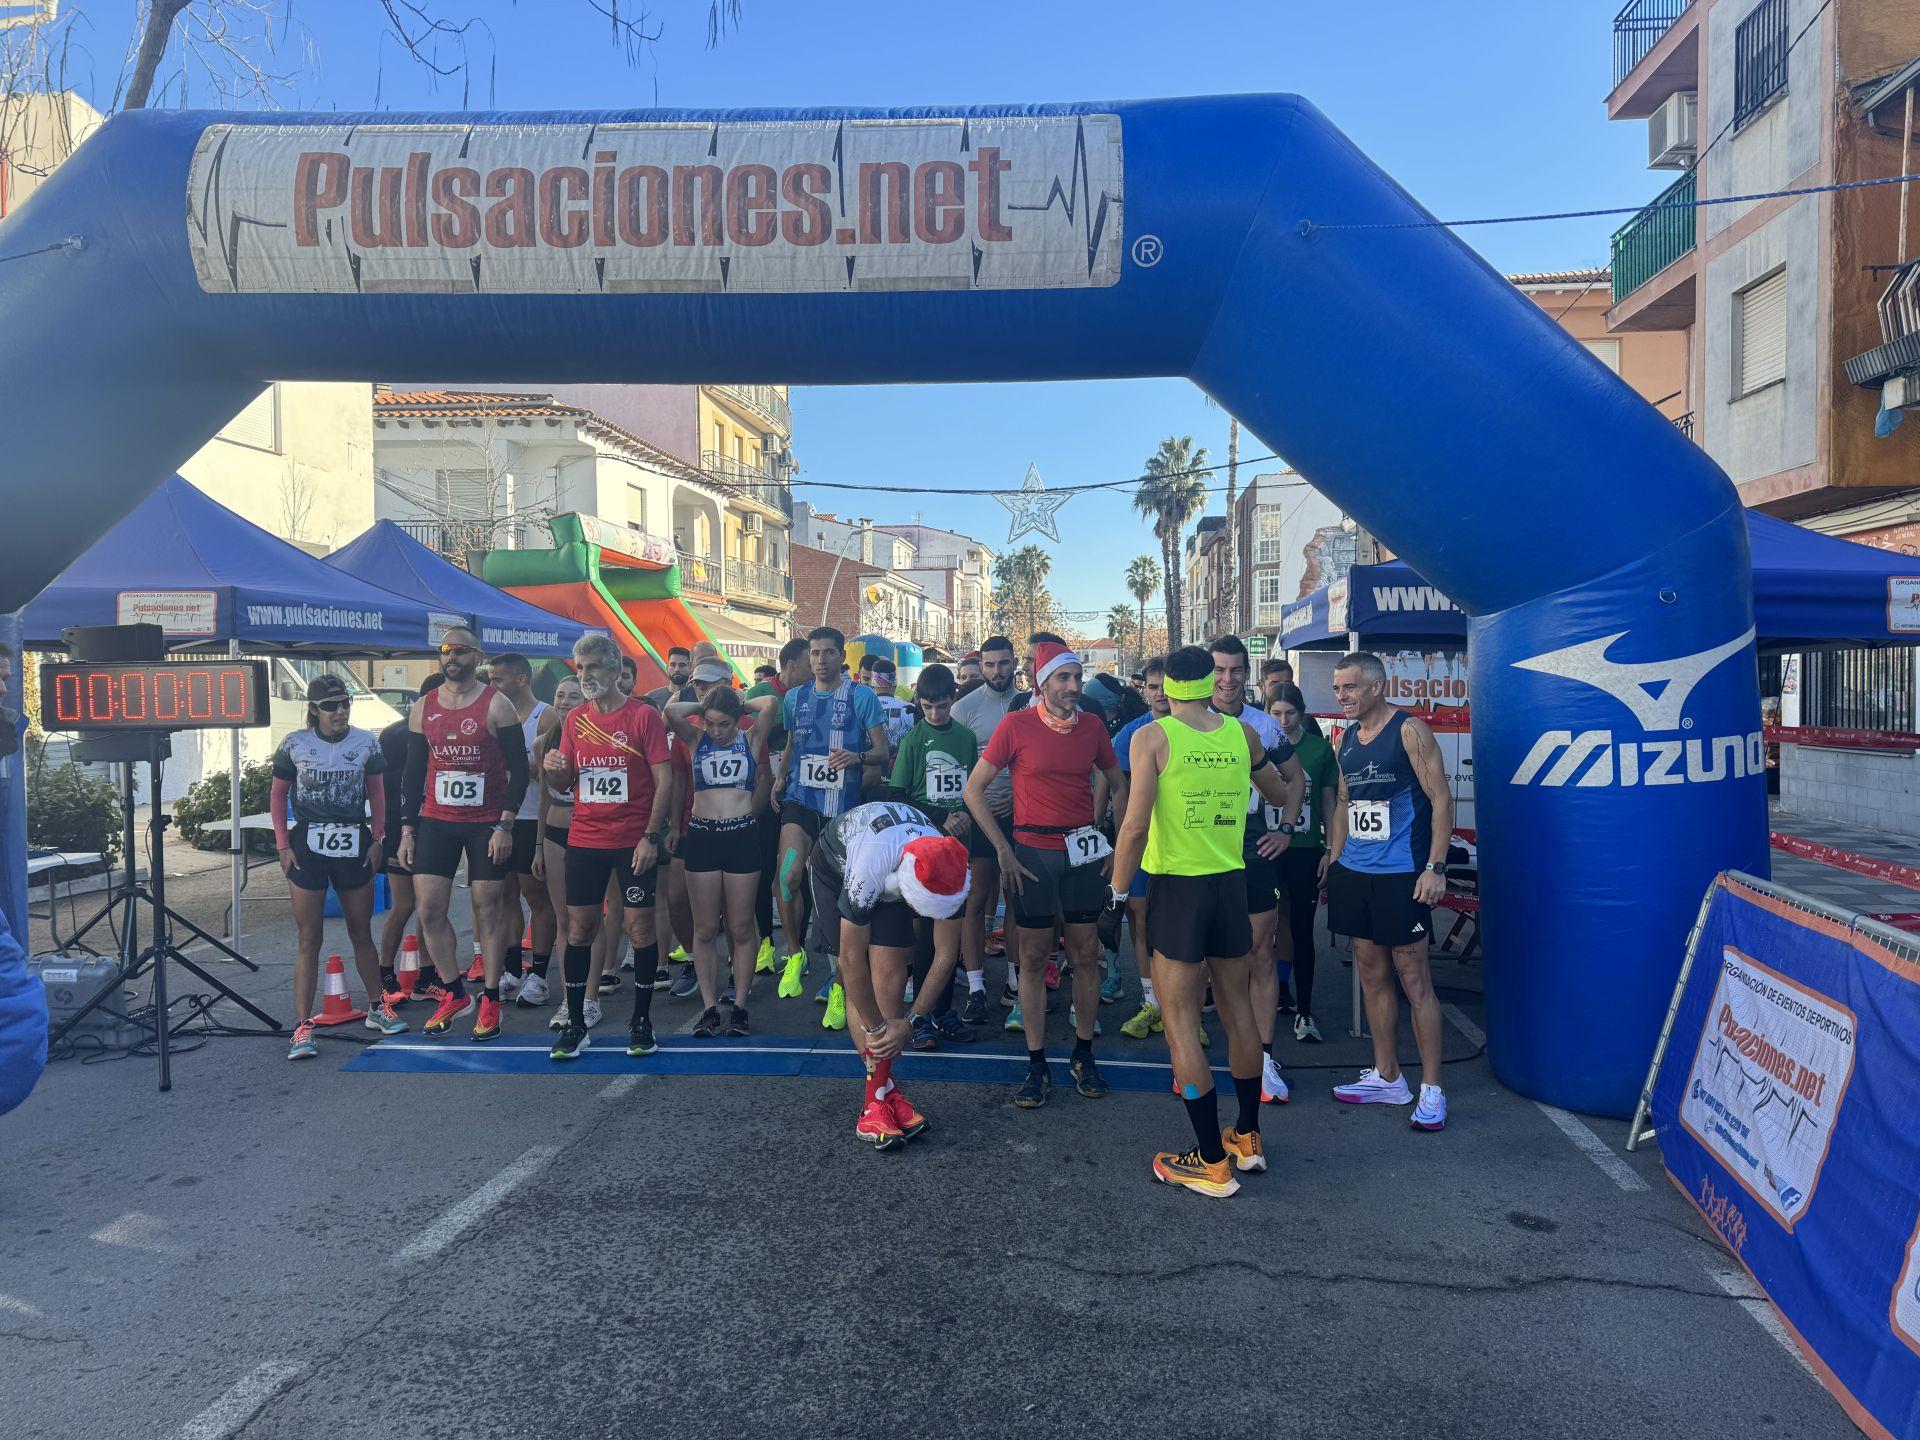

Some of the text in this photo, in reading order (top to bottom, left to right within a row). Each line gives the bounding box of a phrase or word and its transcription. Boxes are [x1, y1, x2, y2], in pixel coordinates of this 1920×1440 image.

[294, 146, 1013, 250] Pulsaciones.net
[247, 603, 383, 631] www.pulsaciones.net
[56, 671, 246, 721] 00:00:00
[434, 745, 481, 756] LAWDE
[582, 756, 627, 767] LAWDE
[709, 759, 742, 778] 167
[807, 764, 839, 782] 168
[442, 780, 477, 799] 103
[587, 777, 621, 796] 142
[934, 774, 962, 793] 155
[1353, 811, 1382, 832] 165
[317, 832, 353, 851] 163
[1076, 834, 1099, 857] 97
[1805, 1008, 1853, 1046] DEPORTIVOS
